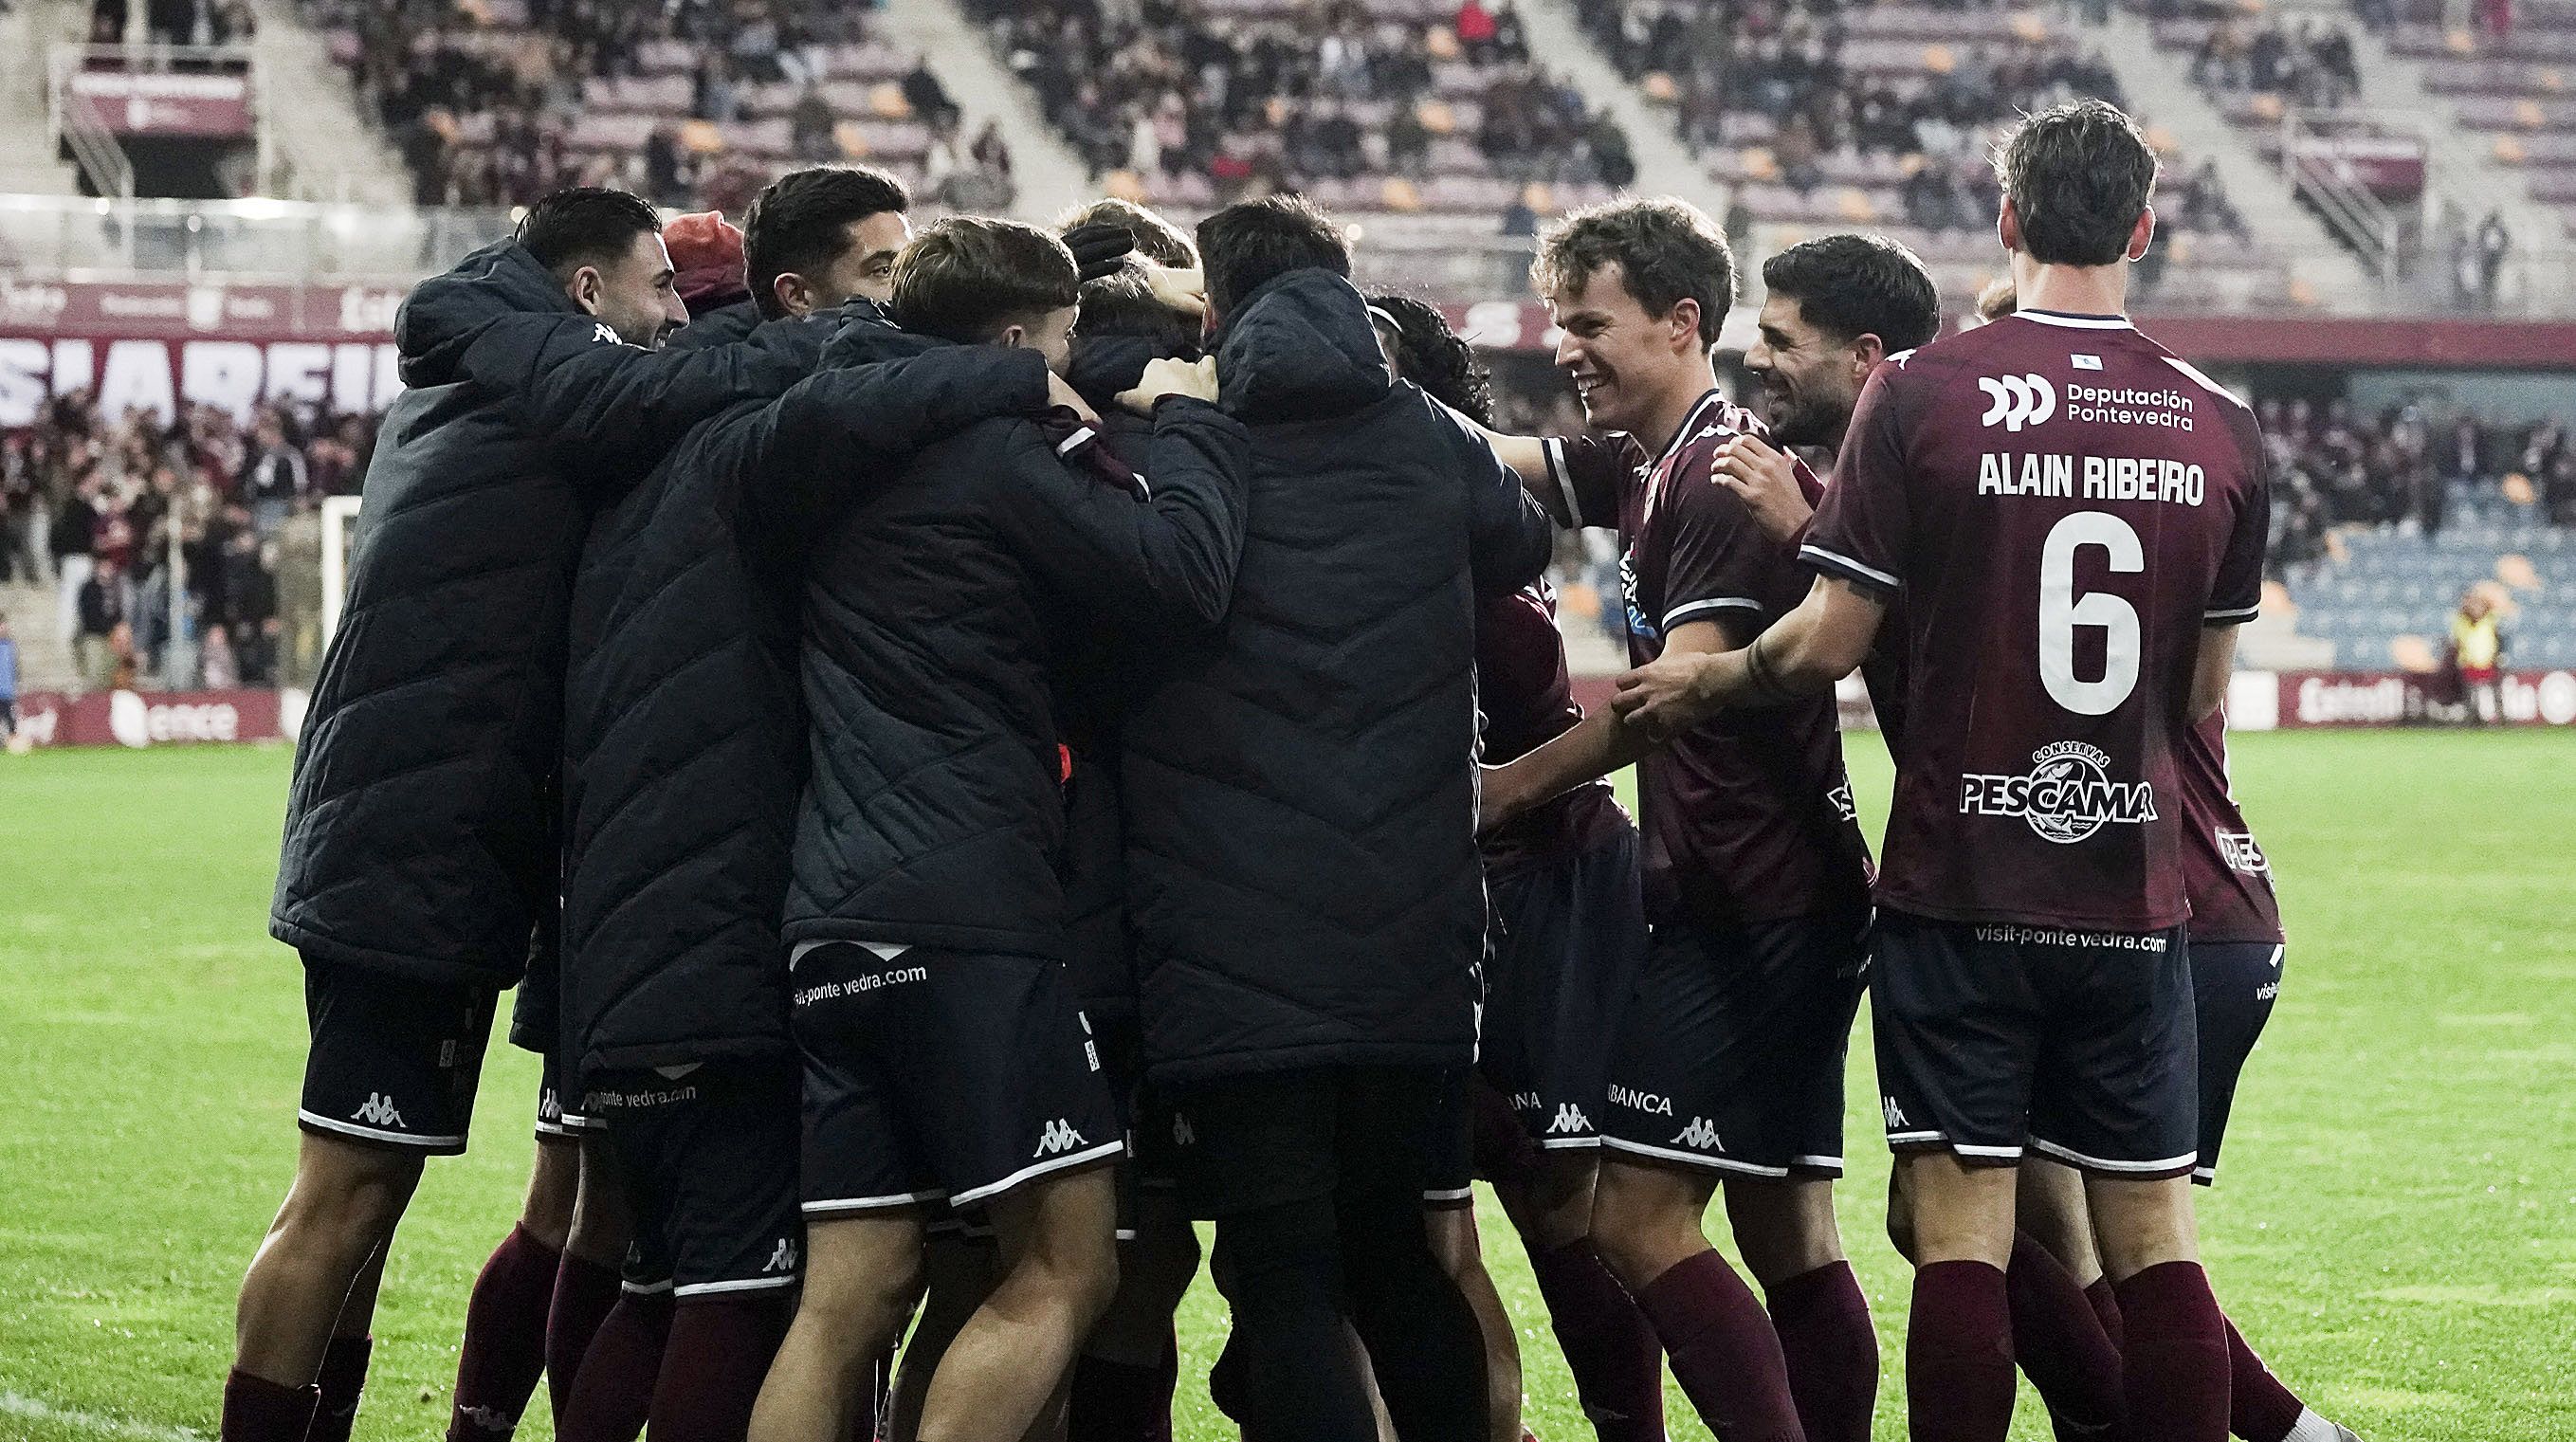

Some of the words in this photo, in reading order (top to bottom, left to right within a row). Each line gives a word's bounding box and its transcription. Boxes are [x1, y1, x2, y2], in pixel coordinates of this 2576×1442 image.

[2067, 383, 2193, 413] Deputación
[2067, 404, 2193, 432] Pontevedra
[1978, 452, 2074, 499] ALAIN
[2083, 456, 2205, 507] RIBEIRO
[2039, 511, 2145, 716] 6
[2032, 740, 2111, 769] CONSERVAS
